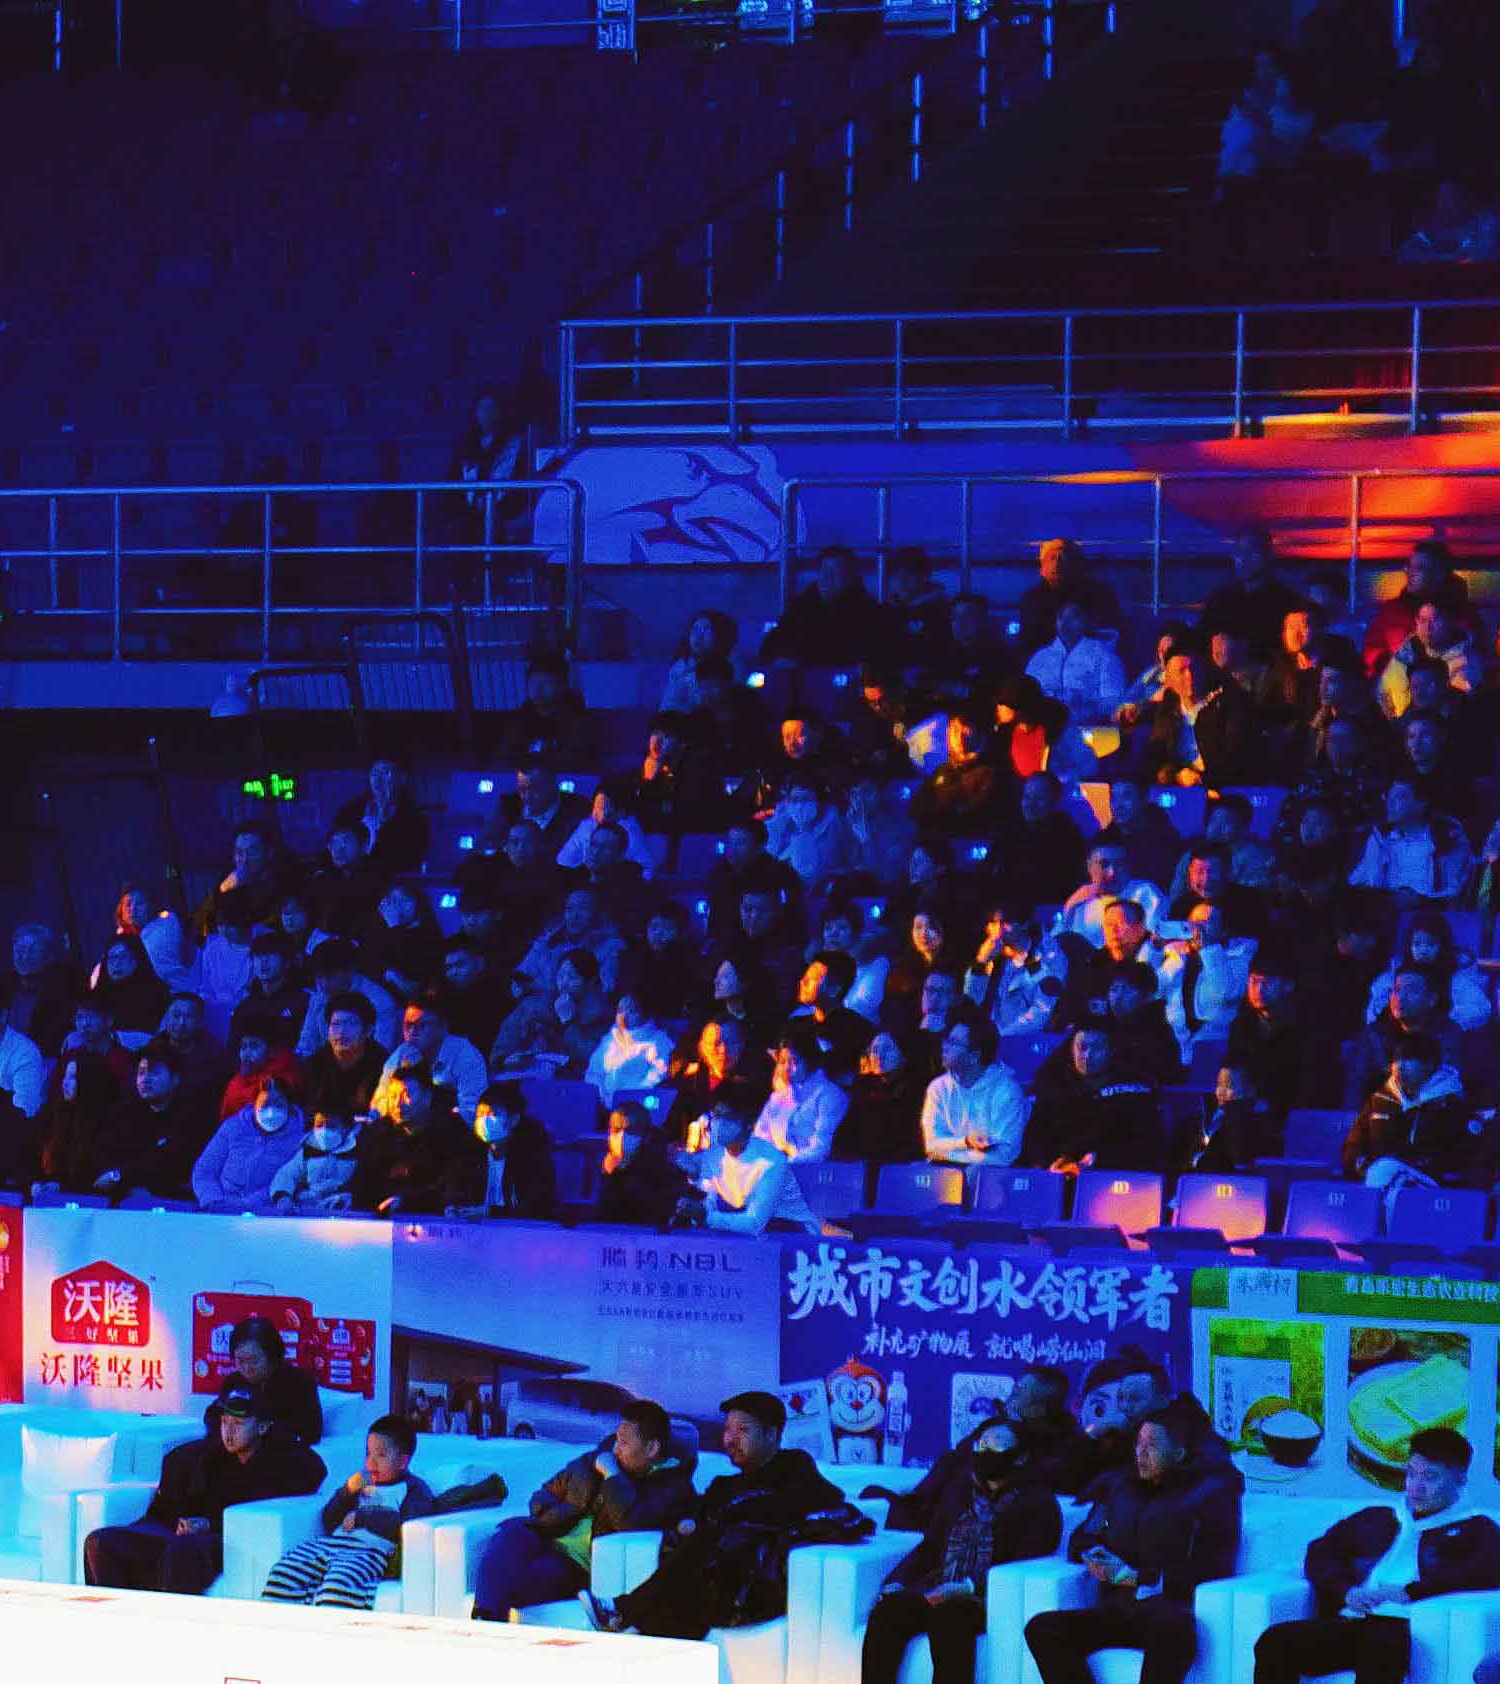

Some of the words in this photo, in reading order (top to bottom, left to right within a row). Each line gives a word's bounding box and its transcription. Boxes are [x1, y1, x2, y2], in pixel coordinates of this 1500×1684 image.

[63, 1279, 139, 1326] 沃隆
[787, 1243, 1179, 1331] 城市文创水领军者
[40, 1352, 164, 1393] 沃隆坚果
